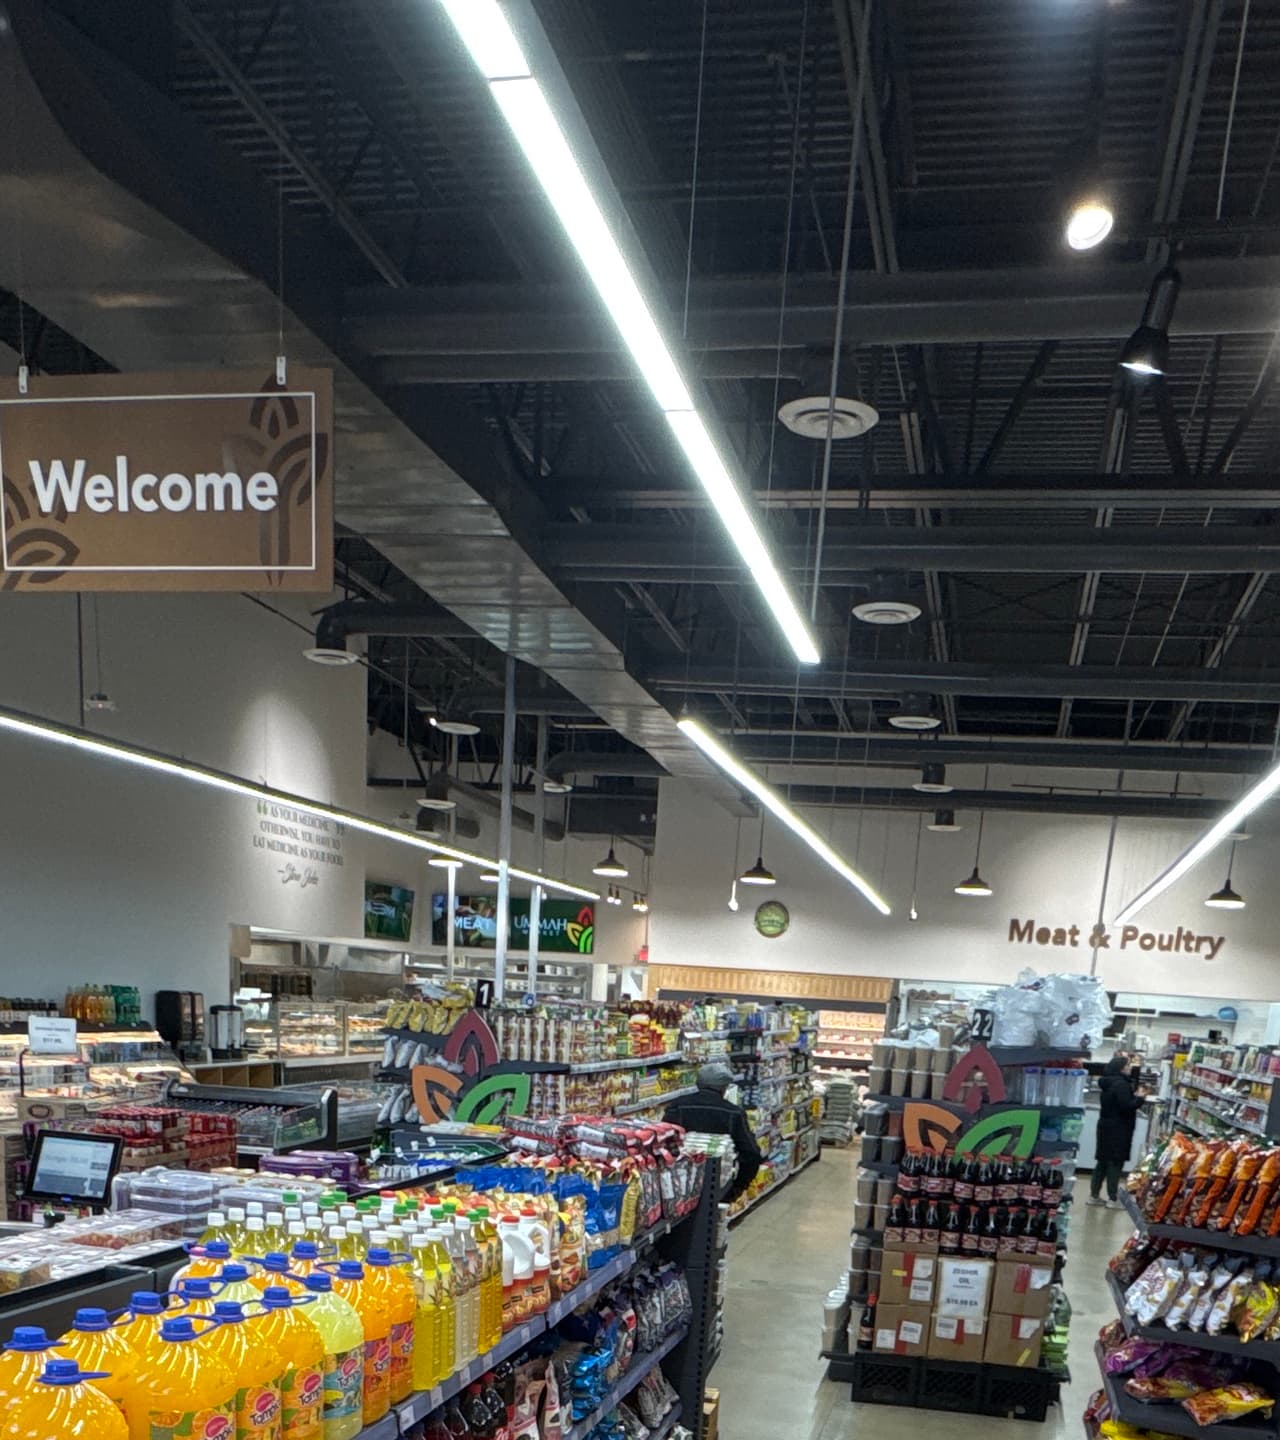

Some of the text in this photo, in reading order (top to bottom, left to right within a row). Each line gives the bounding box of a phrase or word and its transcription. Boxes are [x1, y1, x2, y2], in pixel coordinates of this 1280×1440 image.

[28, 455, 279, 513] Welcome
[1008, 919, 1225, 961] Meat & Poultry
[479, 983, 489, 1006] 1
